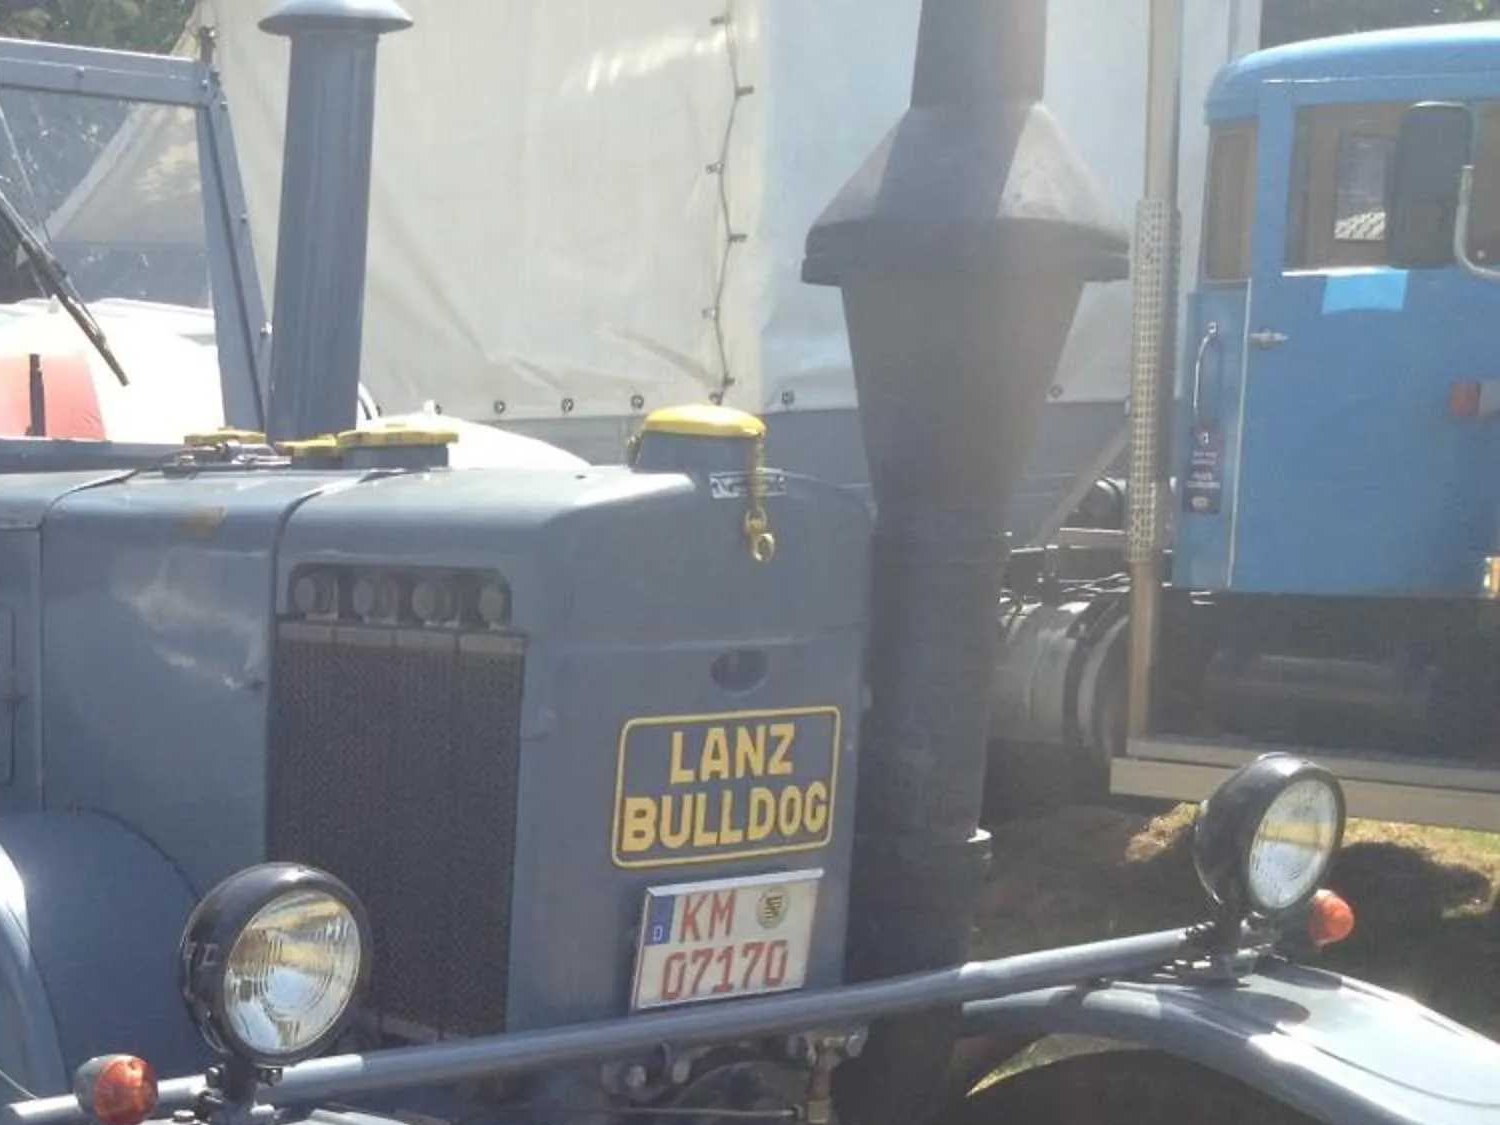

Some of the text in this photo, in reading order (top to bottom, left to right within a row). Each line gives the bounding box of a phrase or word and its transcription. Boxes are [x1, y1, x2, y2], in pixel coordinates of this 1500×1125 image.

[669, 722, 795, 784] LANZ
[621, 781, 828, 852] BULLDOG
[652, 925, 663, 941] D
[678, 889, 737, 943] KM
[661, 939, 790, 1000] 07170
